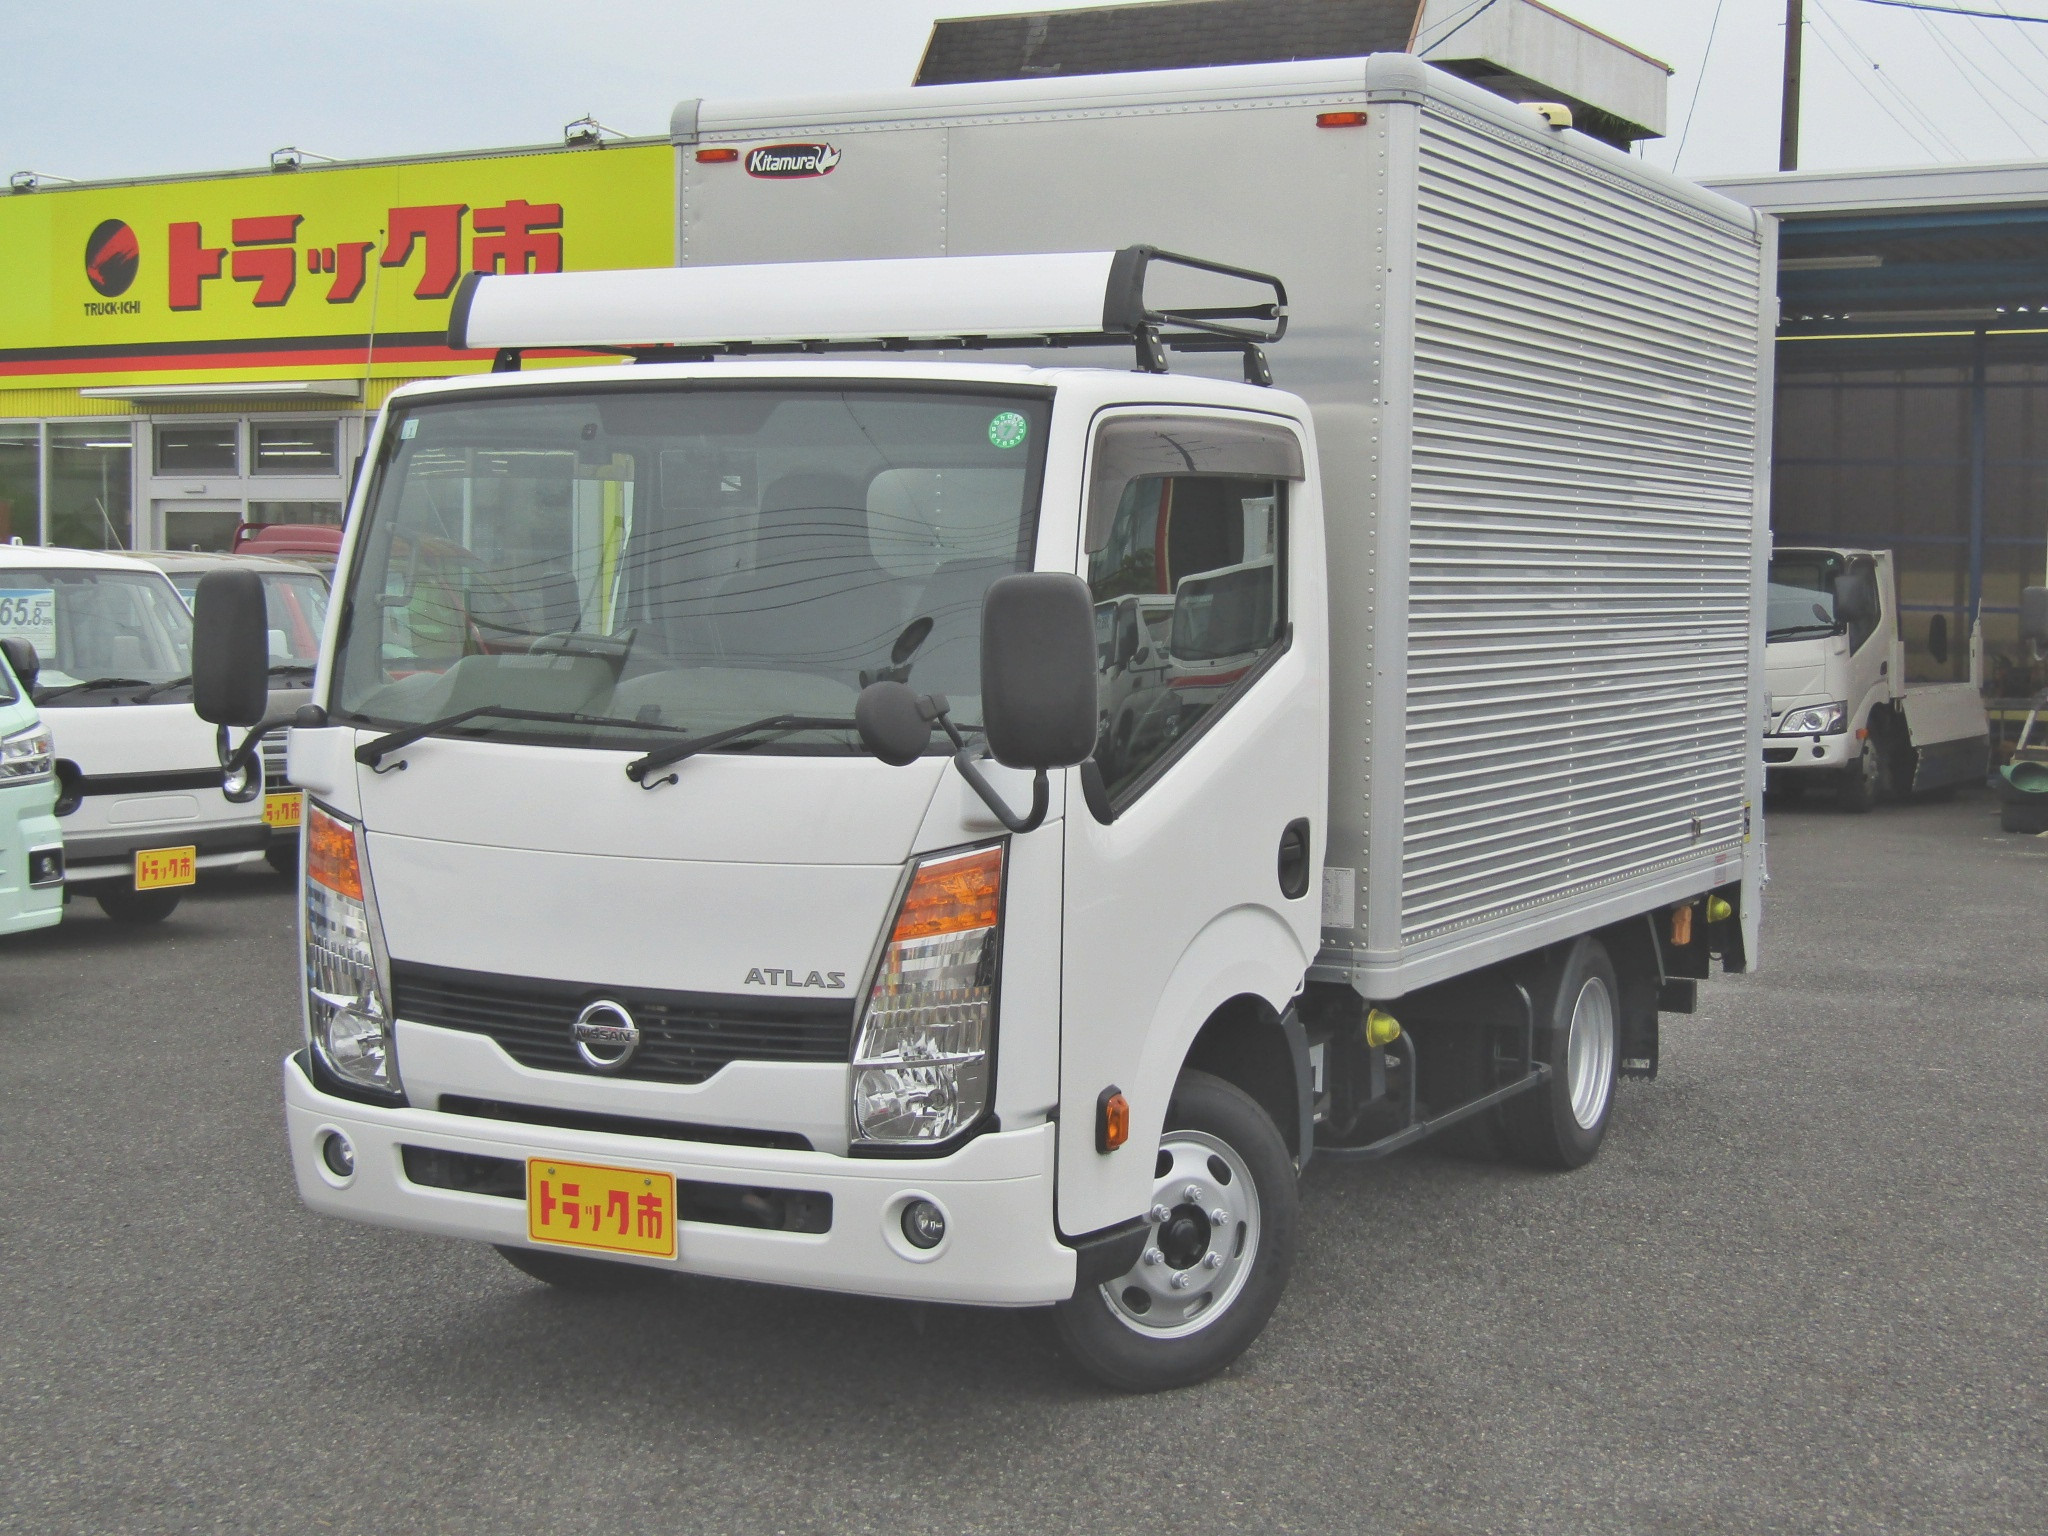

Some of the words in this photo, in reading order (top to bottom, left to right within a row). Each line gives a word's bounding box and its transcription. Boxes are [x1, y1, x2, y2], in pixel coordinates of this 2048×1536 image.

[750, 150, 816, 172] Kitamura
[168, 199, 563, 312] トラック市
[266, 801, 300, 821] ラック市
[141, 857, 190, 882] トラック市
[744, 967, 845, 989] ATLAS
[575, 1027, 631, 1042] NISSAN
[540, 1180, 663, 1240] トラック市
